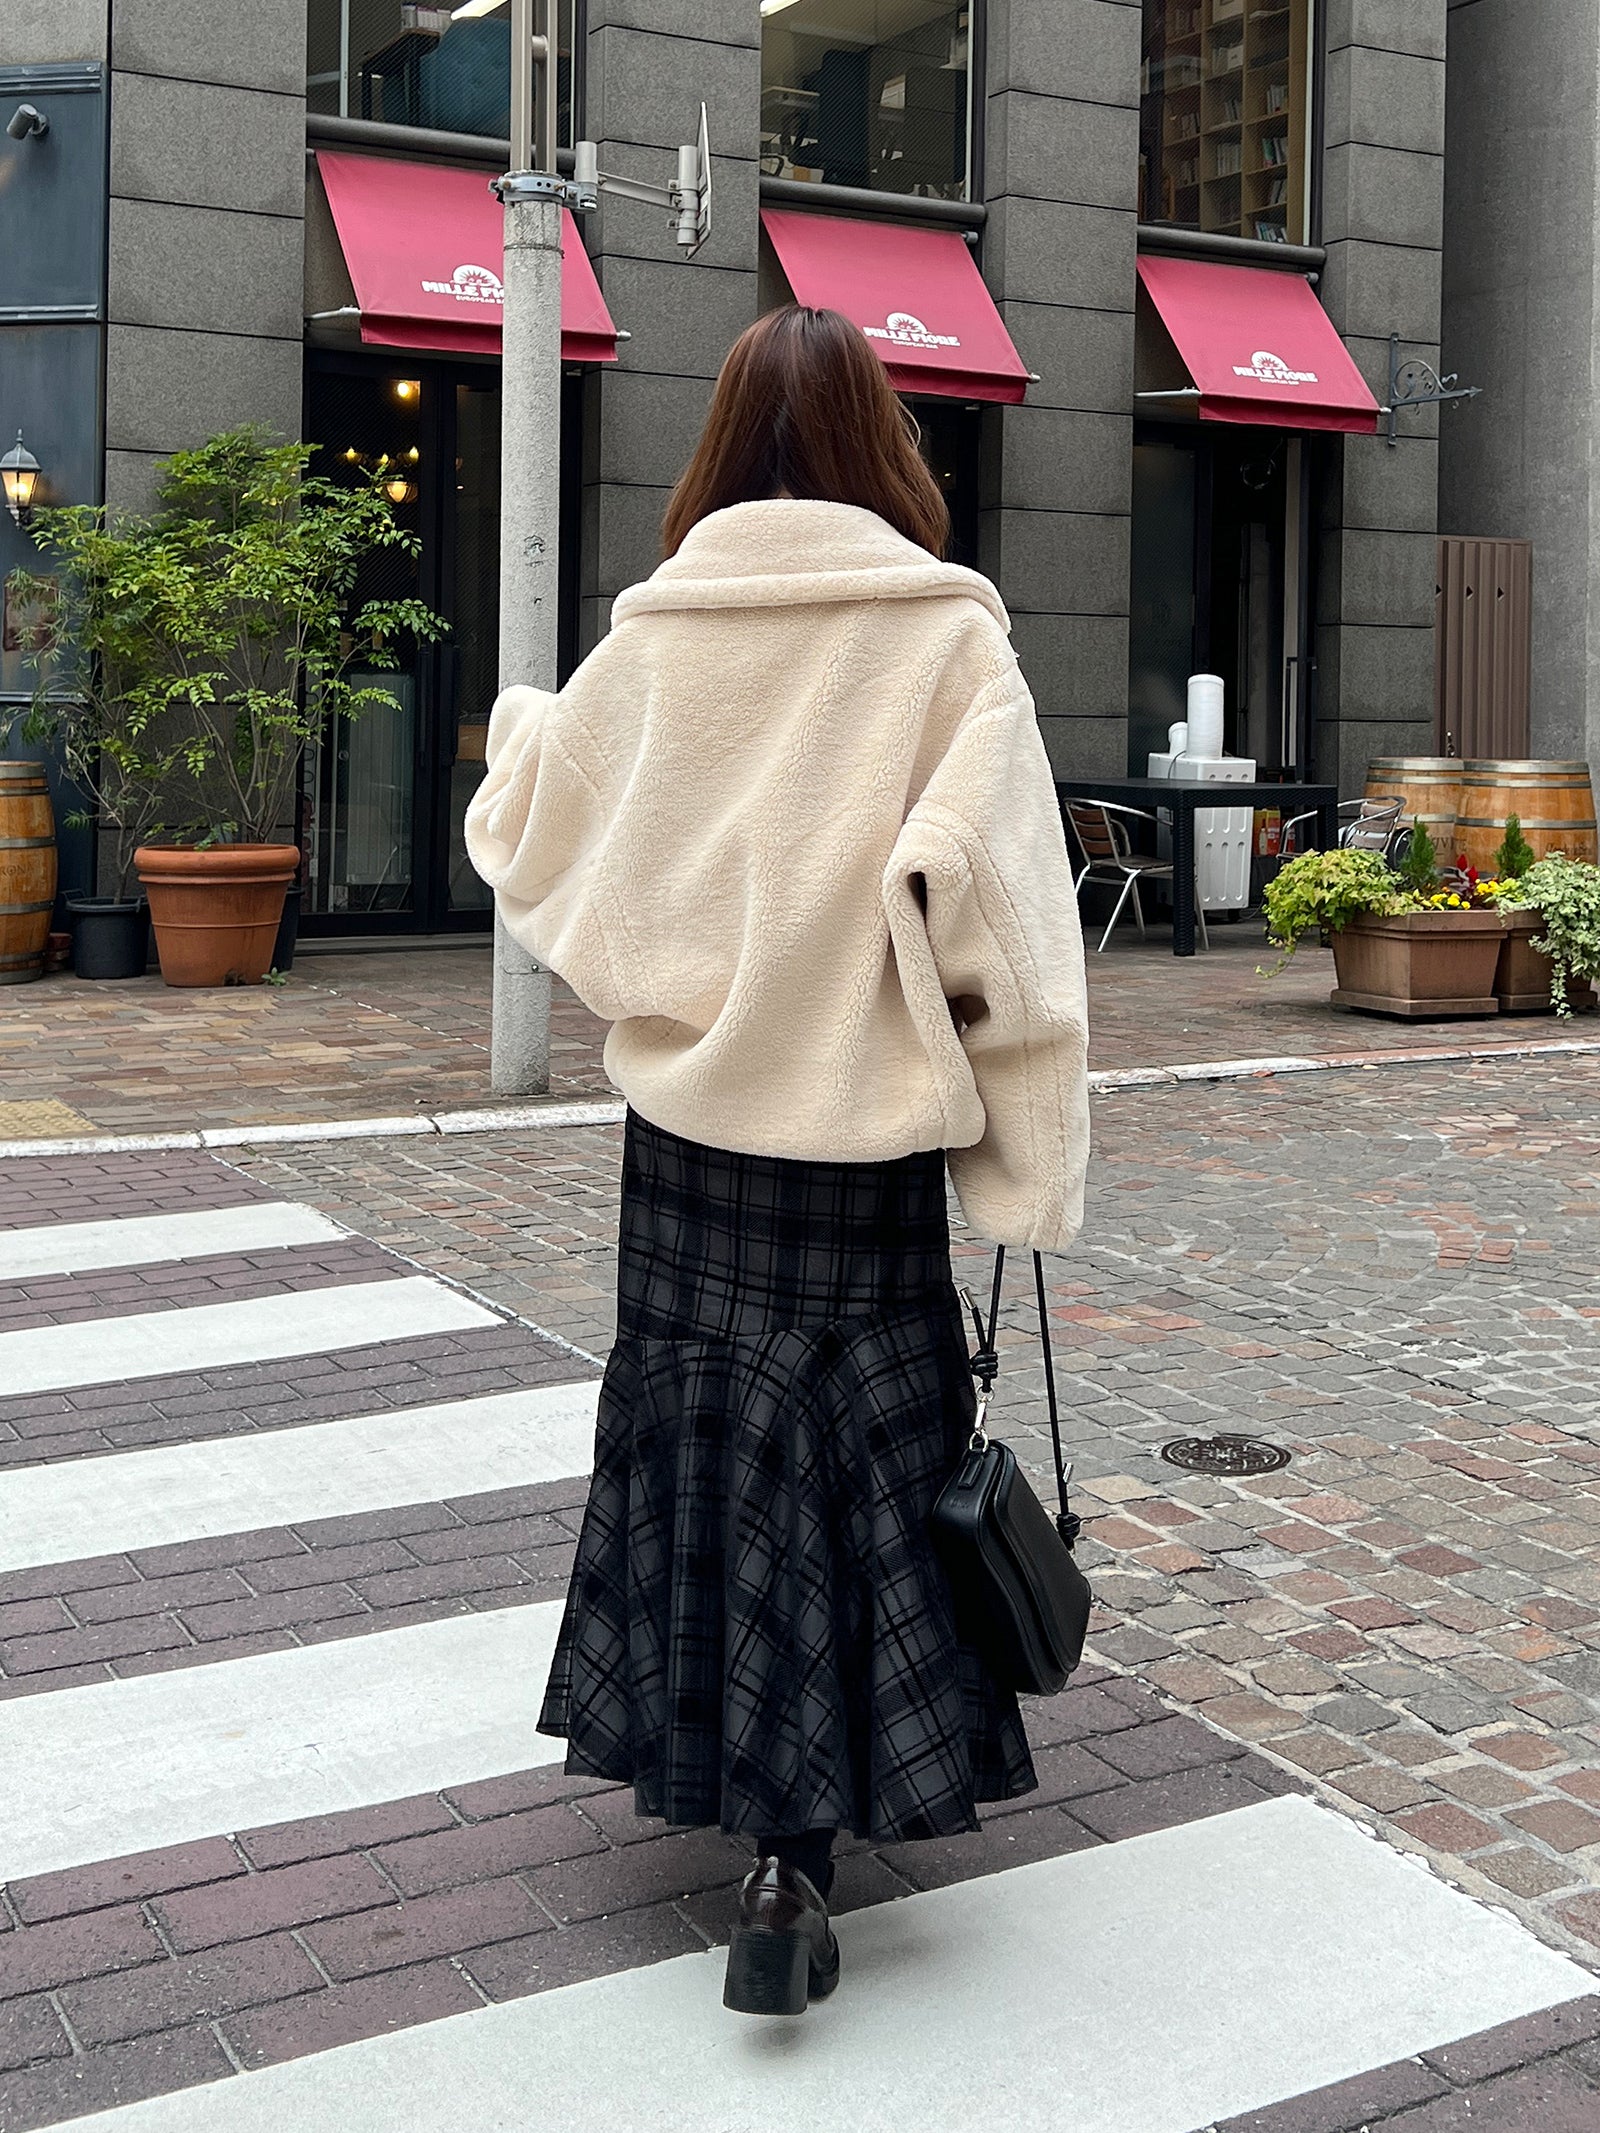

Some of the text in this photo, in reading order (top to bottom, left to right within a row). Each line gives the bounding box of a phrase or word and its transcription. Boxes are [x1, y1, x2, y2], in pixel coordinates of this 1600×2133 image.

[421, 280, 480, 297] MILLE
[862, 327, 961, 347] MILLE FIORE
[1232, 366, 1319, 383] MILLE FIORE
